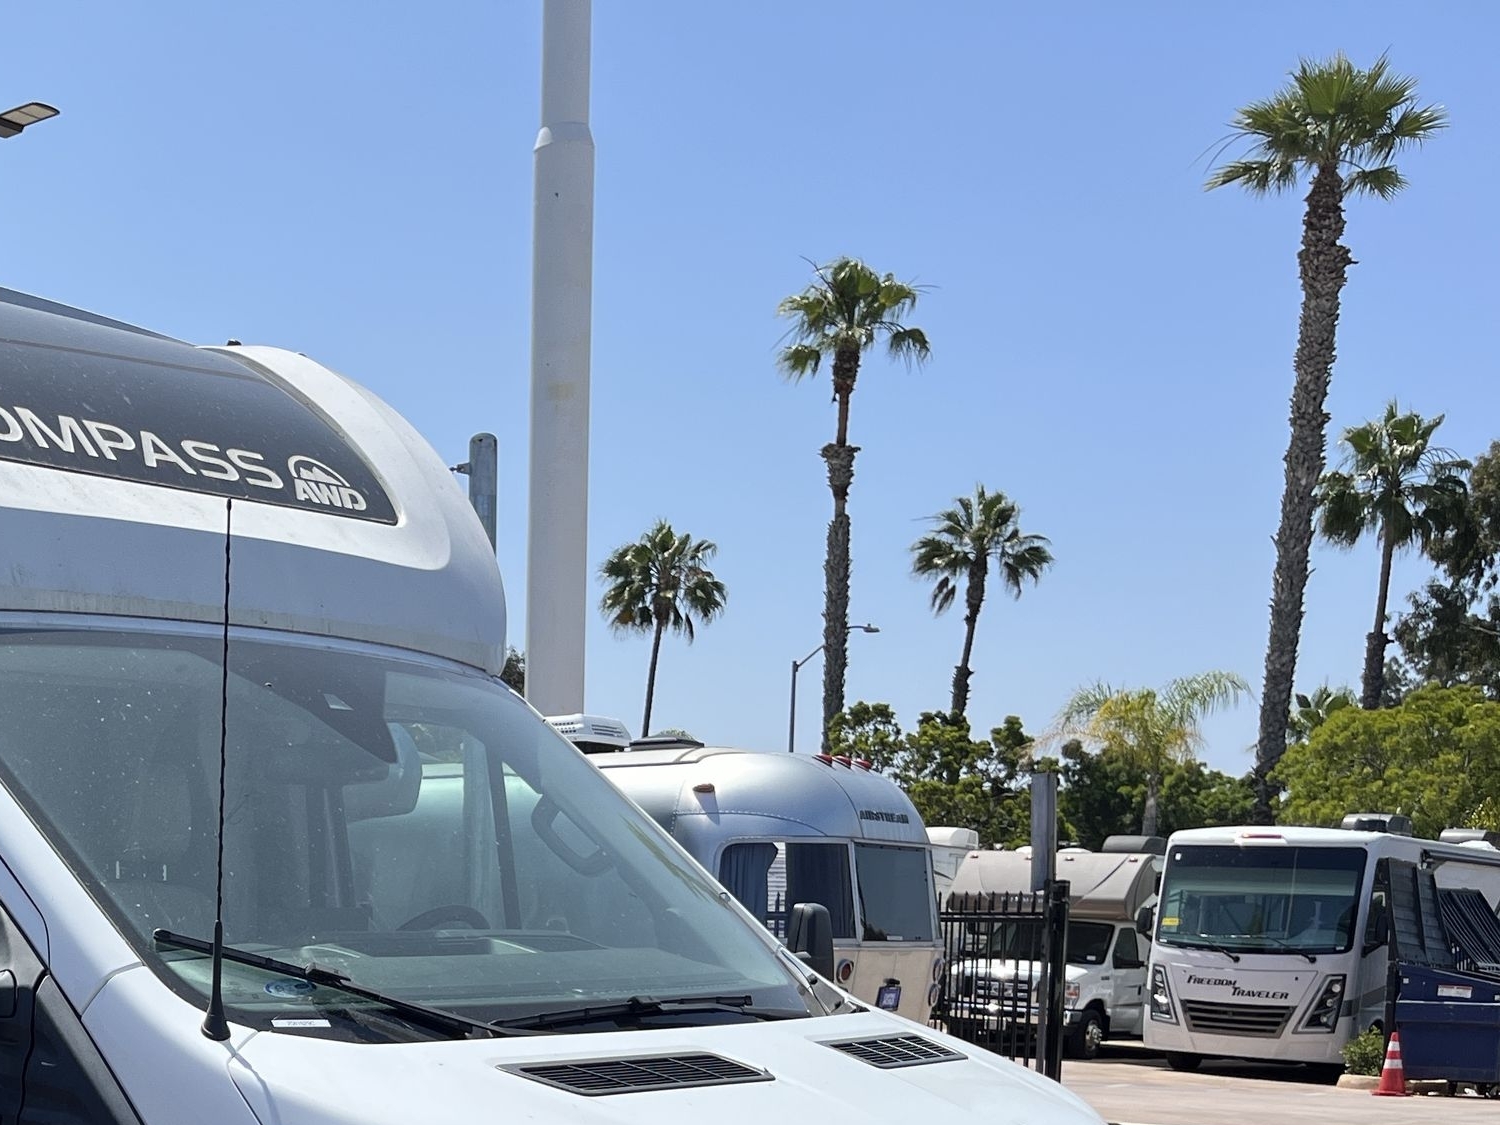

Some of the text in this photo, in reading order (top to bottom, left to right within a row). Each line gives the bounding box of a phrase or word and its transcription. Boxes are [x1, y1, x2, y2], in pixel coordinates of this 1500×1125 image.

[295, 477, 367, 512] AWD
[1187, 974, 1237, 987] FREEDOM
[1231, 986, 1289, 1000] TRAVELER
